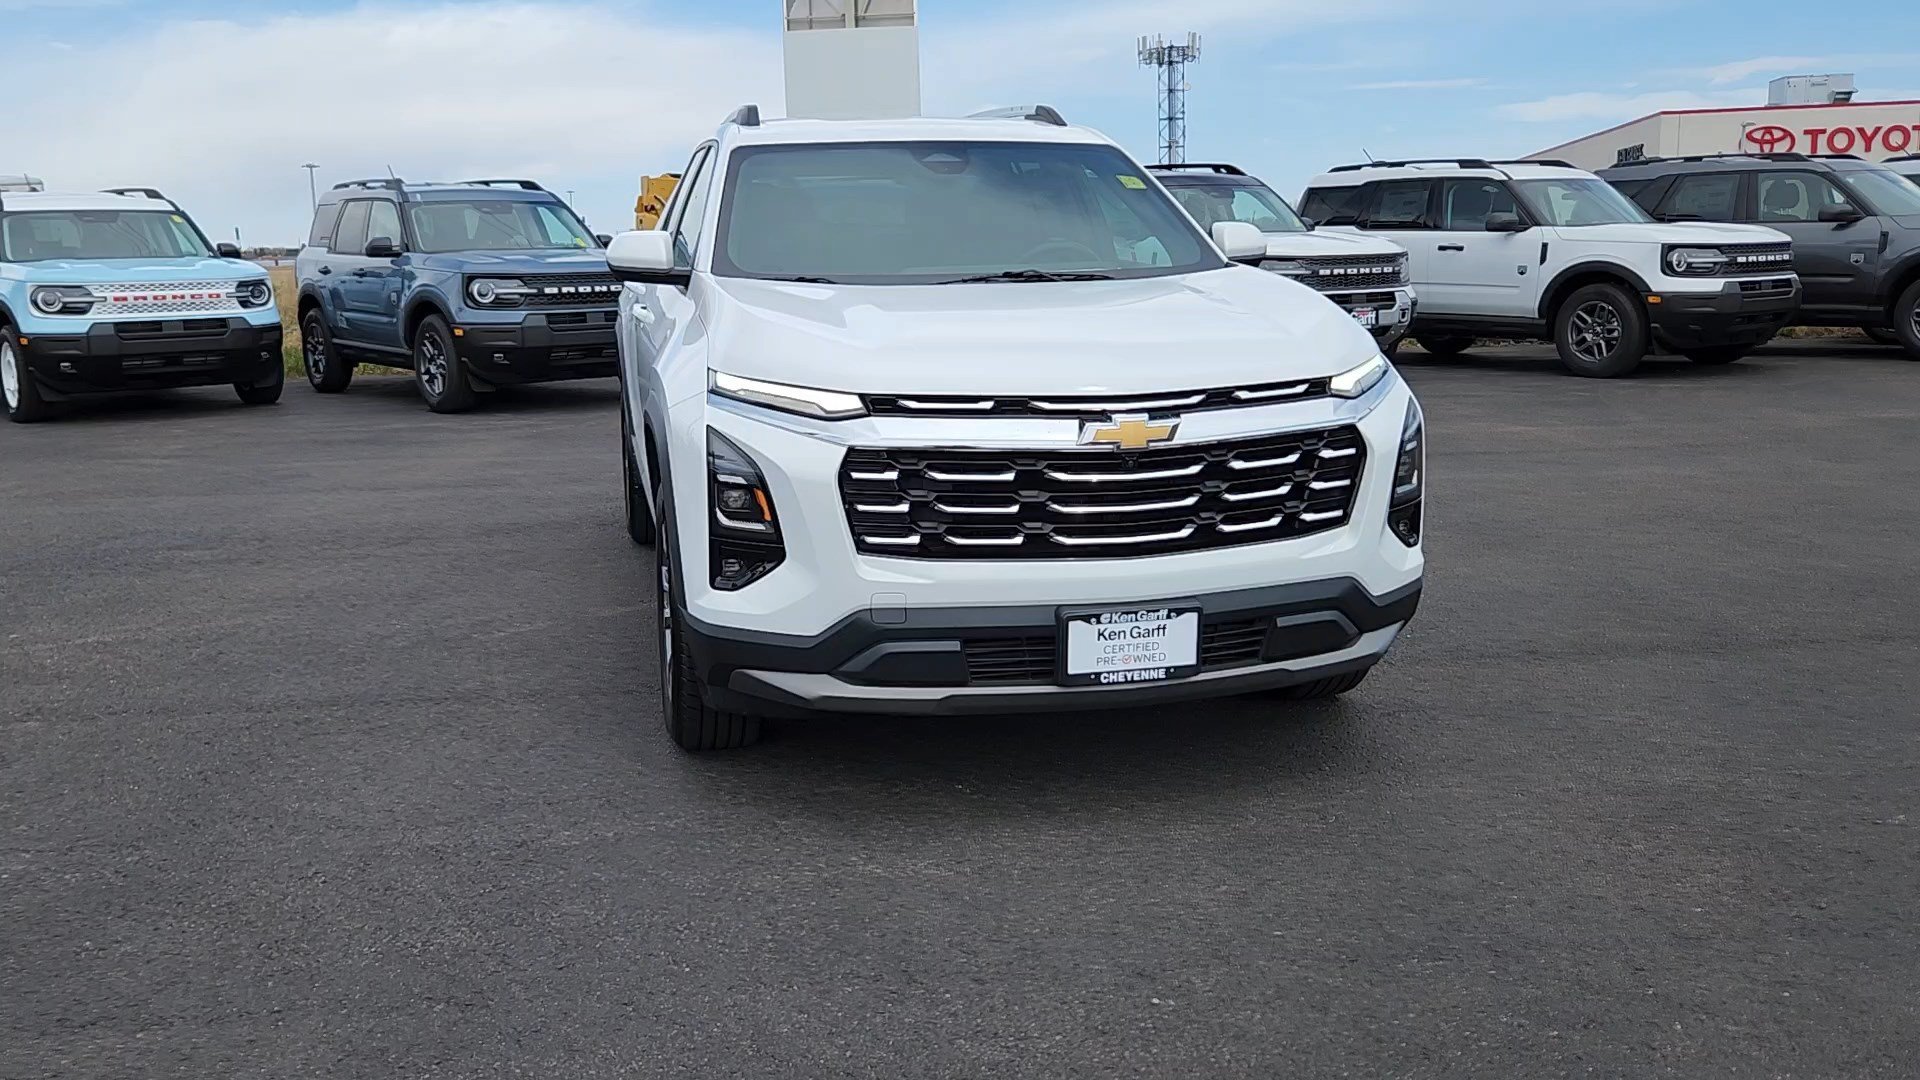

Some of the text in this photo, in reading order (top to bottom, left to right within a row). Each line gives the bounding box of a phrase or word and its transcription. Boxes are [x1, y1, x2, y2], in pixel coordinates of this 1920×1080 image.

[1737, 254, 1790, 263] BRONCO
[1318, 266, 1394, 276] BRONCO
[543, 284, 623, 294] BRONC
[112, 293, 221, 302] BRONCO
[1111, 608, 1169, 624] Ken Garff
[1097, 624, 1168, 642] Ken Garff
[1103, 641, 1160, 655] CERTIFIED
[1096, 652, 1167, 667] PRE-OWNED
[1100, 668, 1166, 684] CHEYENNE
